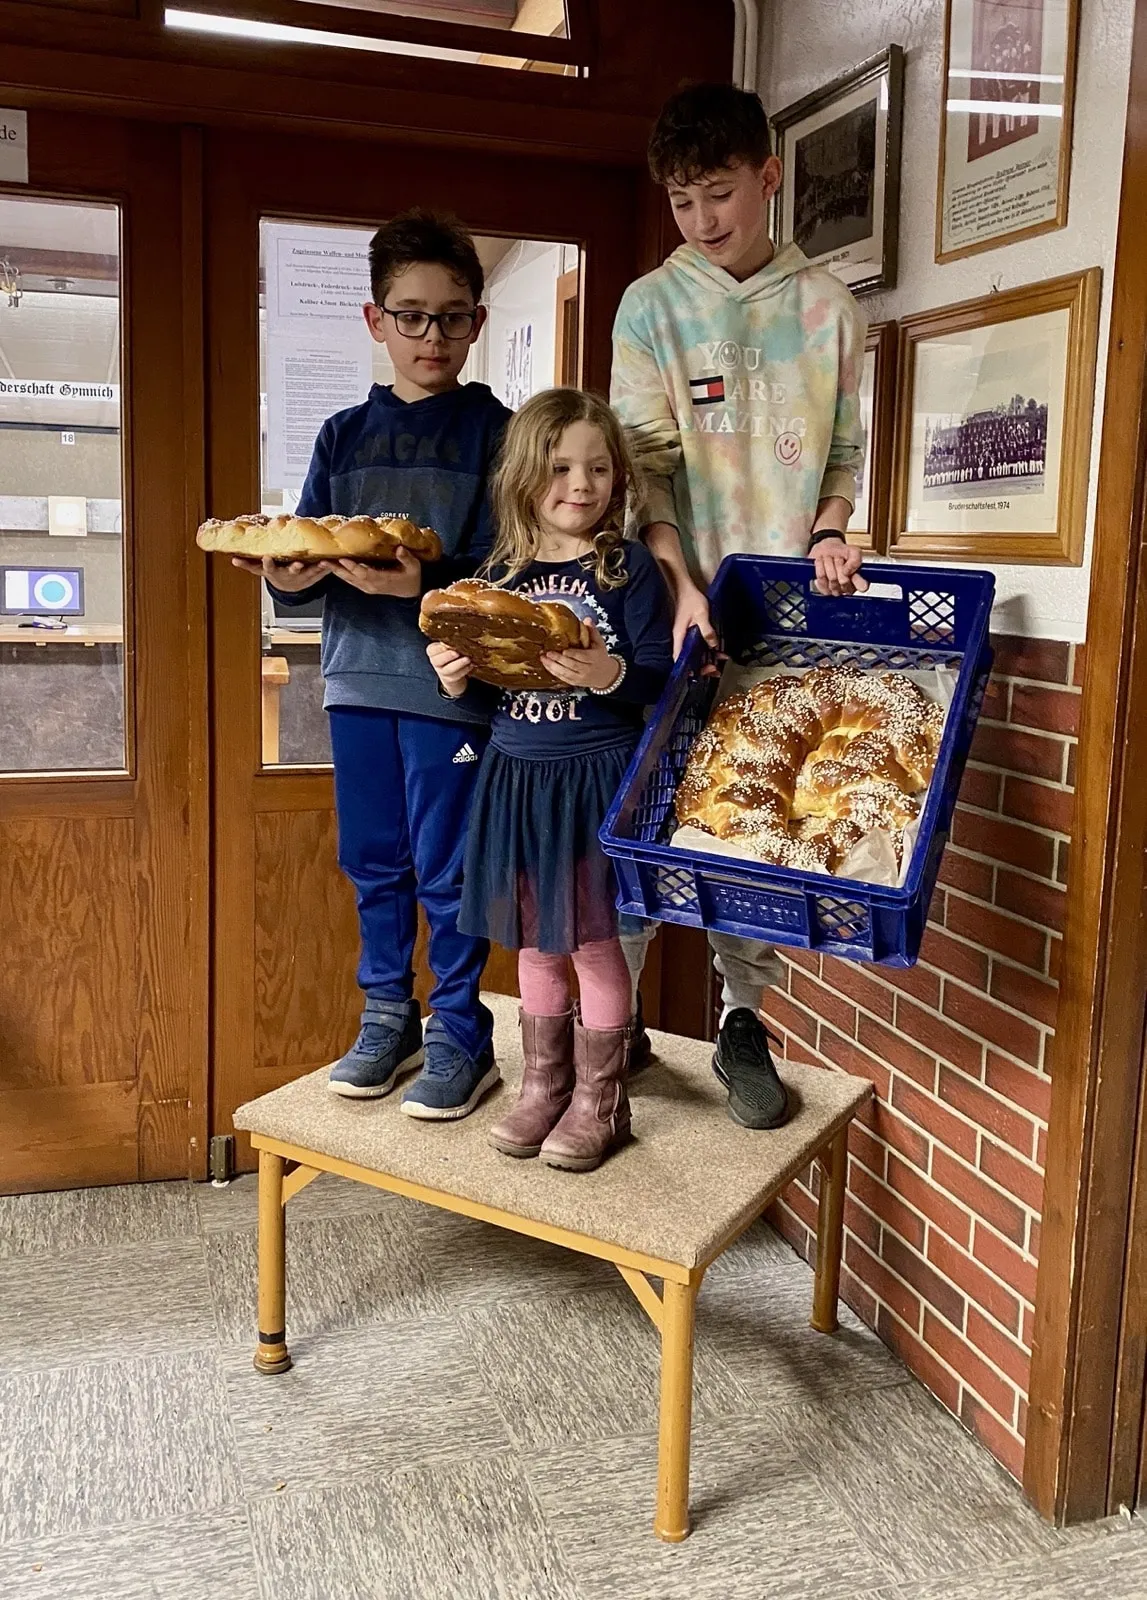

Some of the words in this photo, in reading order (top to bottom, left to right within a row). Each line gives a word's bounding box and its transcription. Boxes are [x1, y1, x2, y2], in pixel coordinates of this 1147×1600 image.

[697, 340, 762, 371] YOU
[59, 383, 113, 399] Gymnich
[729, 379, 787, 404] ARE
[63, 434, 74, 442] 18
[997, 501, 1010, 510] 1974
[514, 574, 588, 597] QUEEN
